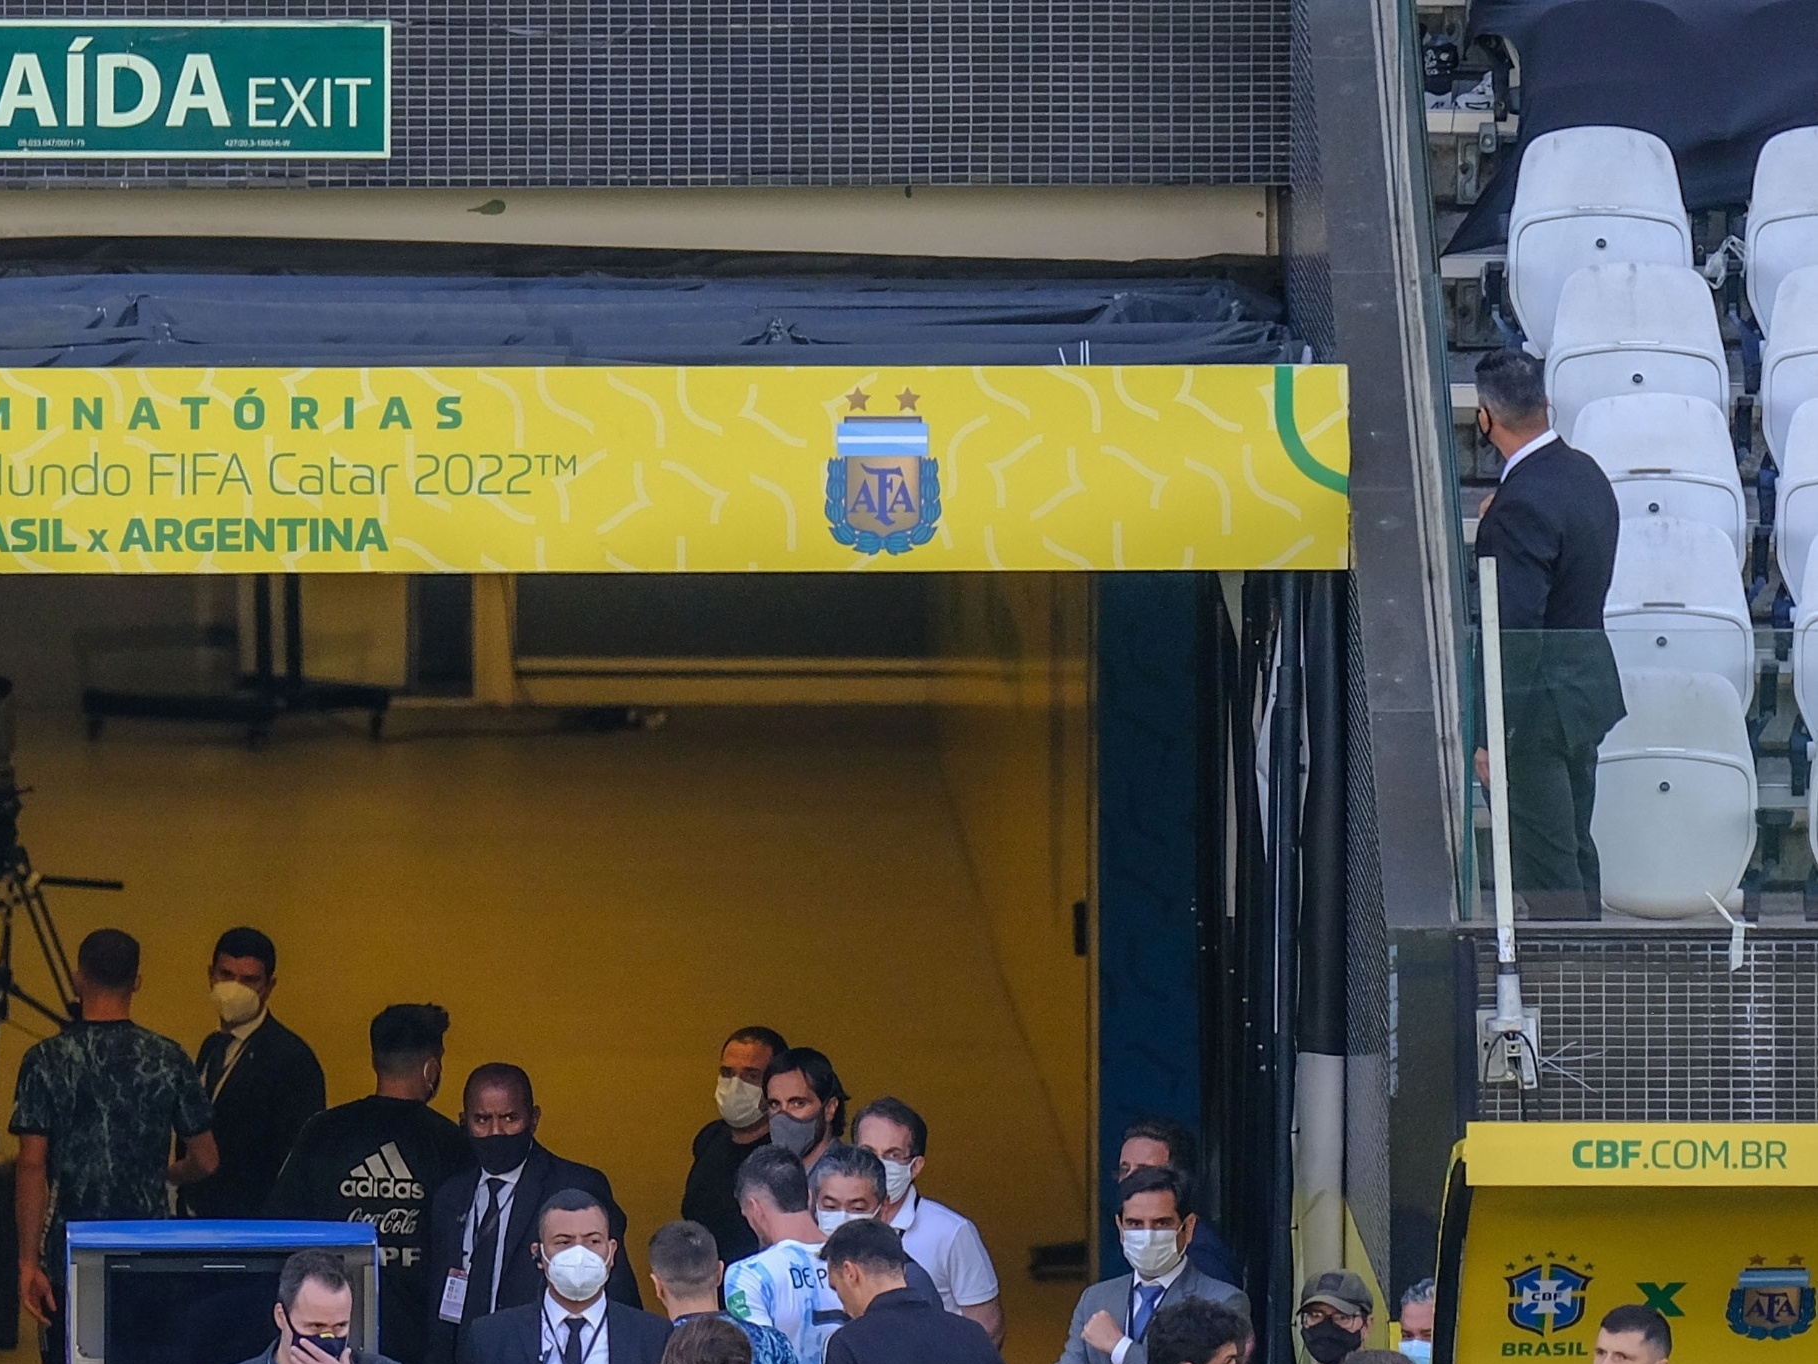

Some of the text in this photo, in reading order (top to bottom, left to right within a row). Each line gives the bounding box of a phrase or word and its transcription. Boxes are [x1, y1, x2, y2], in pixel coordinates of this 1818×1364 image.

[248, 77, 372, 128] EXIT
[149, 453, 252, 495] FIFA
[269, 453, 398, 495] Catar
[848, 462, 917, 526] AFA
[87, 529, 109, 553] x
[119, 517, 389, 553] ARGENTINA
[1572, 1139, 1788, 1170] CBF.COM.BR
[339, 1175, 425, 1199] adidas
[378, 1246, 422, 1267] PF
[788, 1267, 815, 1289] DE
[1530, 1292, 1563, 1303] CBF
[1745, 1292, 1797, 1324] AFA
[1501, 1341, 1589, 1357] BRASIL
